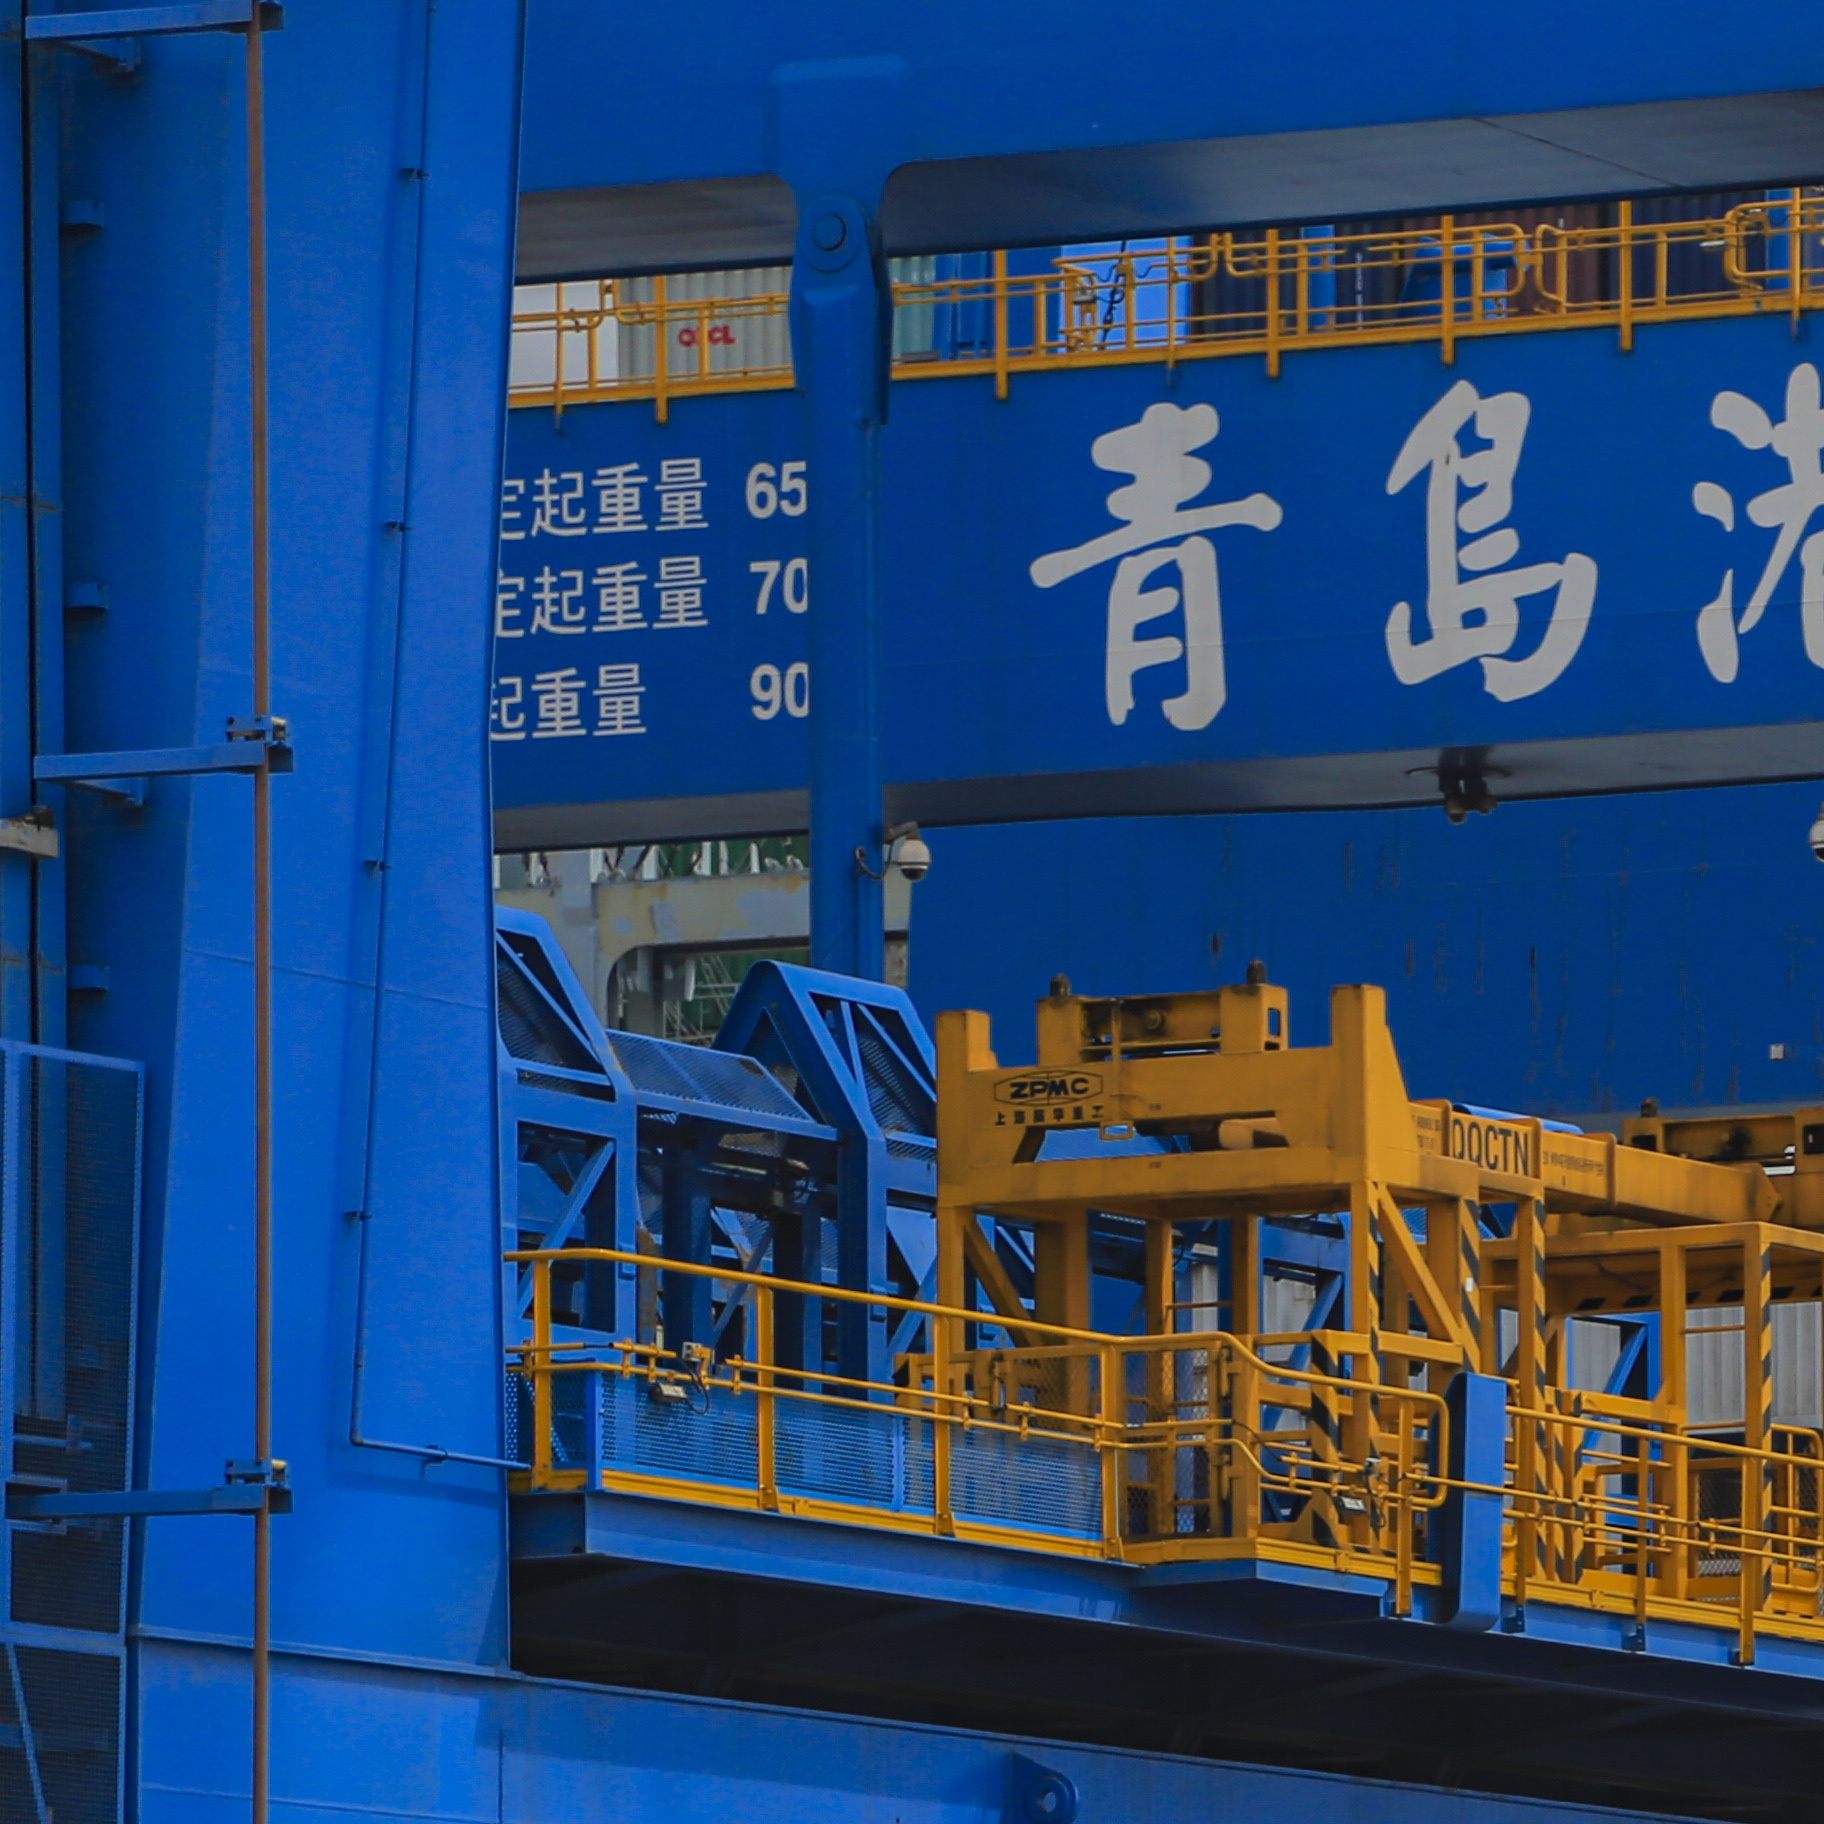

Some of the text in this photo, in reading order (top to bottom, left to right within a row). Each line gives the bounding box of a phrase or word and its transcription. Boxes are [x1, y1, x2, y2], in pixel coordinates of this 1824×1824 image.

[677, 325, 737, 348] OCL
[746, 460, 808, 519] 65
[750, 557, 809, 616] 70
[750, 661, 810, 721] 90
[1010, 1077, 1089, 1099] ZPMC
